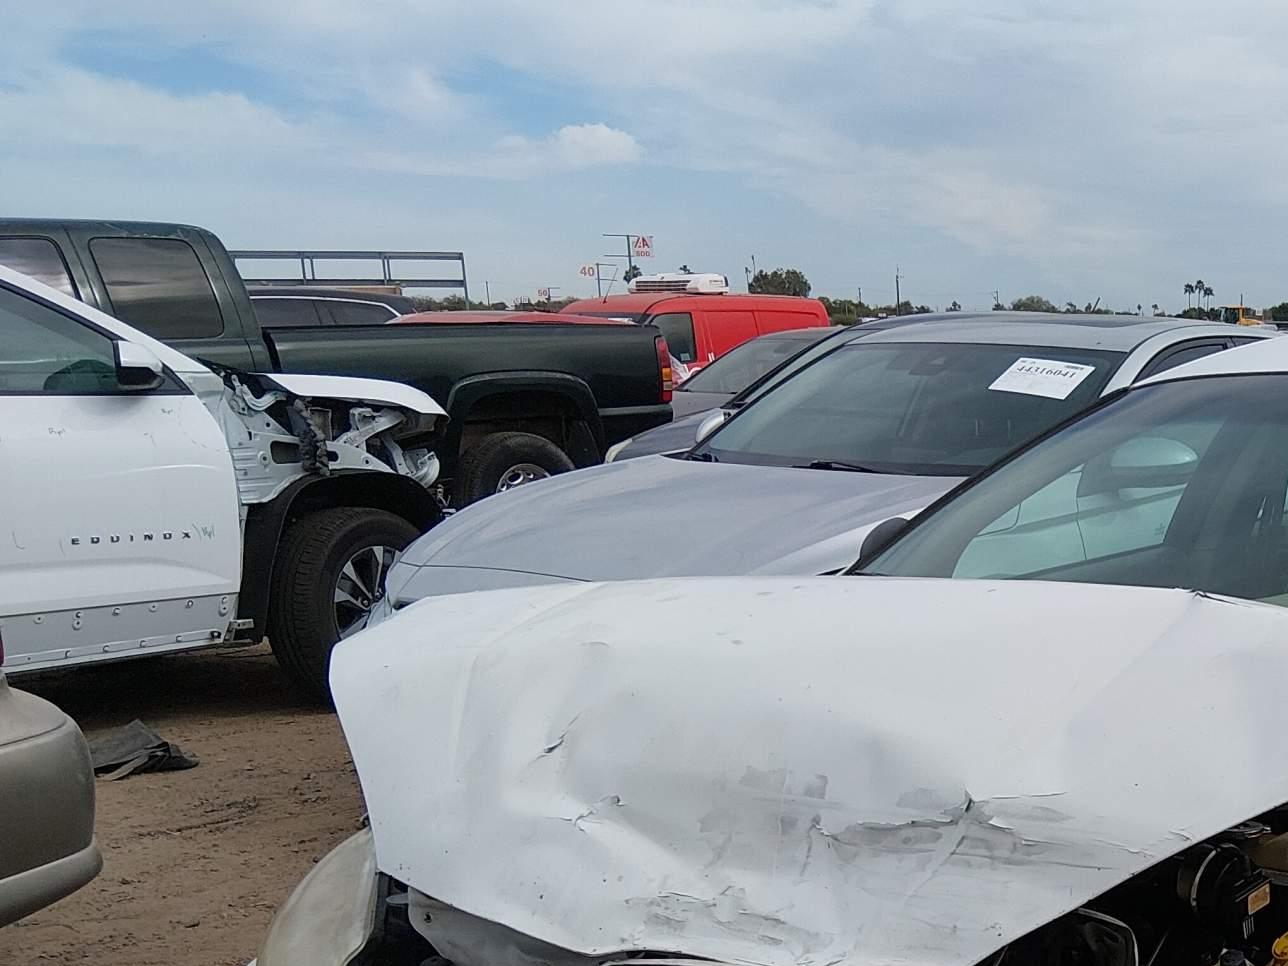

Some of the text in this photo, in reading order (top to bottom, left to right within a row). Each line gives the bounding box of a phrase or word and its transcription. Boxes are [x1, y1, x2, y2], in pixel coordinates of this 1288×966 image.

[579, 266, 595, 277] 40
[1016, 364, 1077, 379] 44316041
[71, 531, 192, 546] EQUINOX
